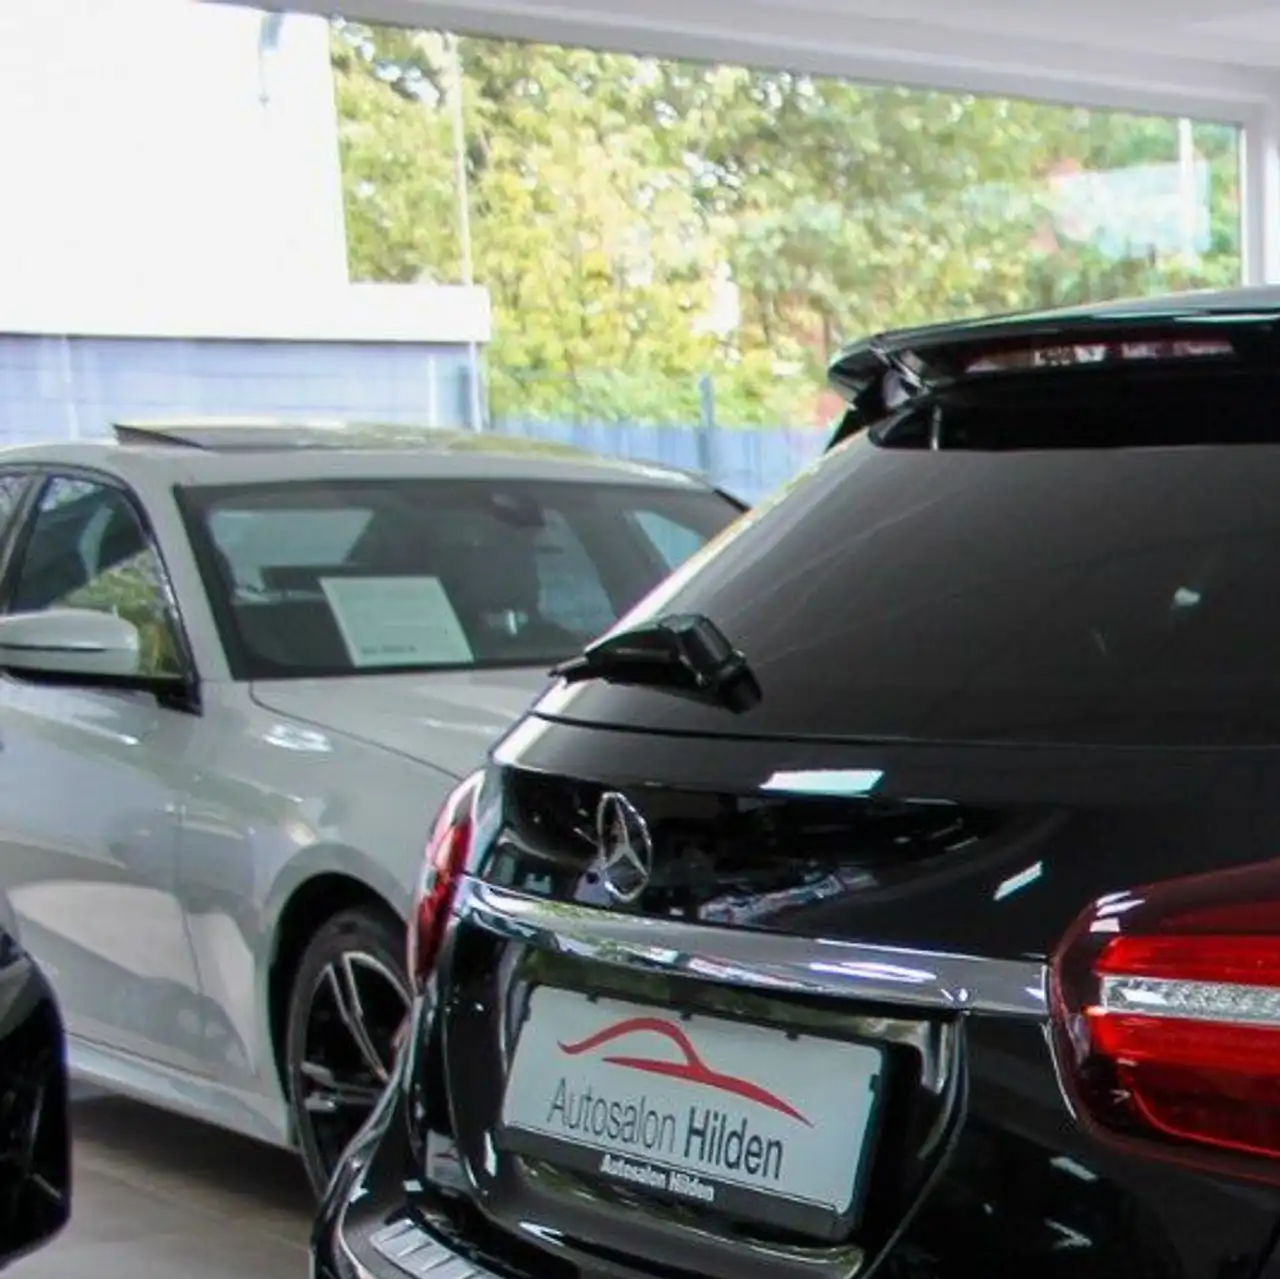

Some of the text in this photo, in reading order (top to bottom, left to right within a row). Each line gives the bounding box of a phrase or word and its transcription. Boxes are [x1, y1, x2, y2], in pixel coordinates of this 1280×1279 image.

[547, 1077, 782, 1179] Autosalon Hilden
[601, 1154, 714, 1202] Autosalon Hilden
